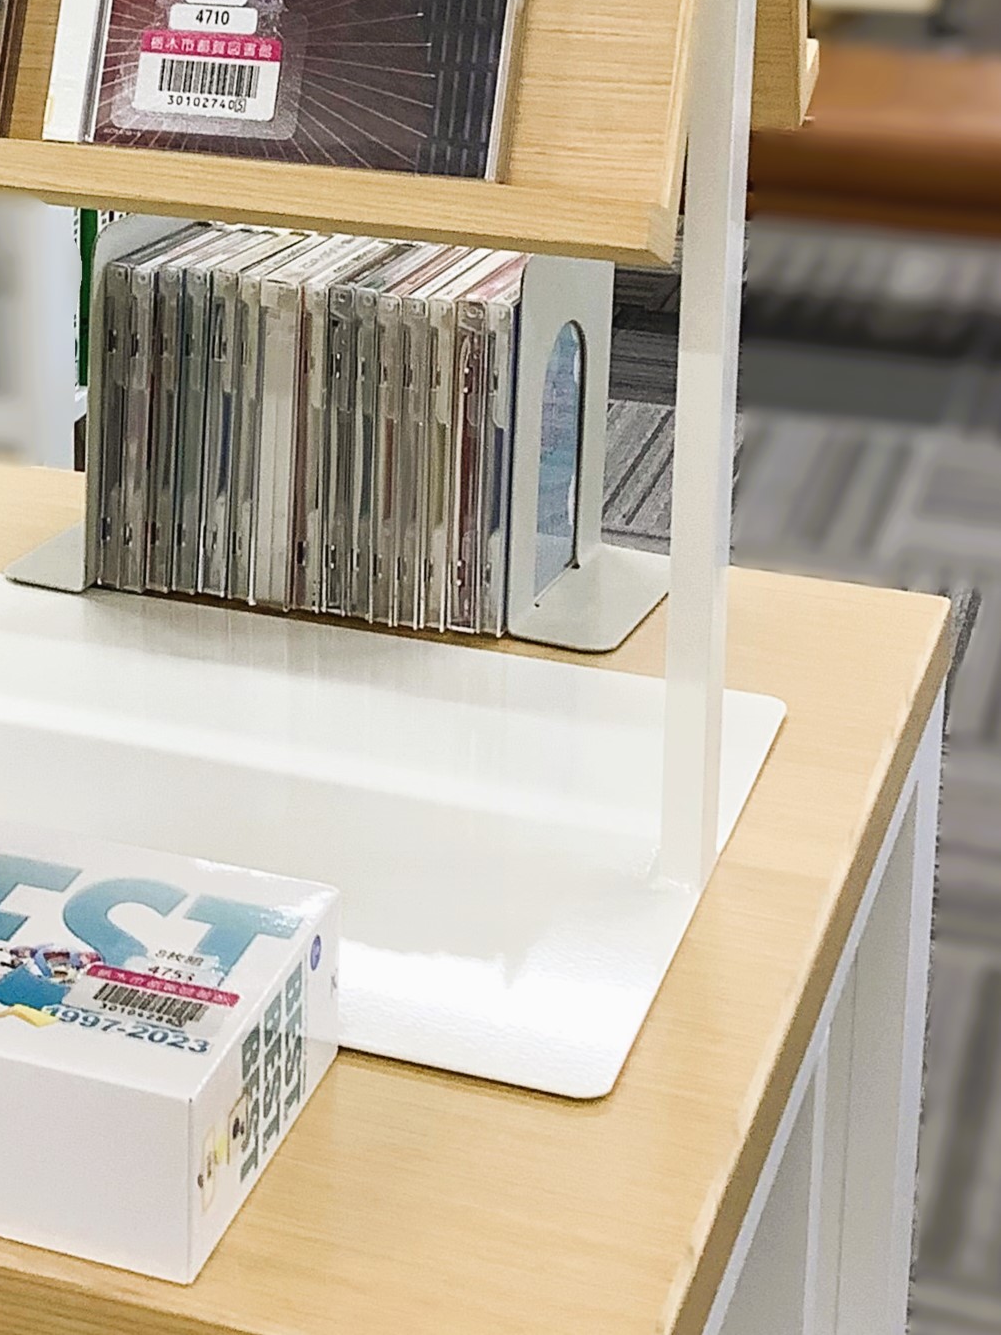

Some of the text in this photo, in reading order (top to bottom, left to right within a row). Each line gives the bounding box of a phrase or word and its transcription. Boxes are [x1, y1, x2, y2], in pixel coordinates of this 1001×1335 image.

[195, 9, 230, 26] 4710
[167, 94, 246, 113] 301027405
[44, 1005, 212, 1054] 1997-2023
